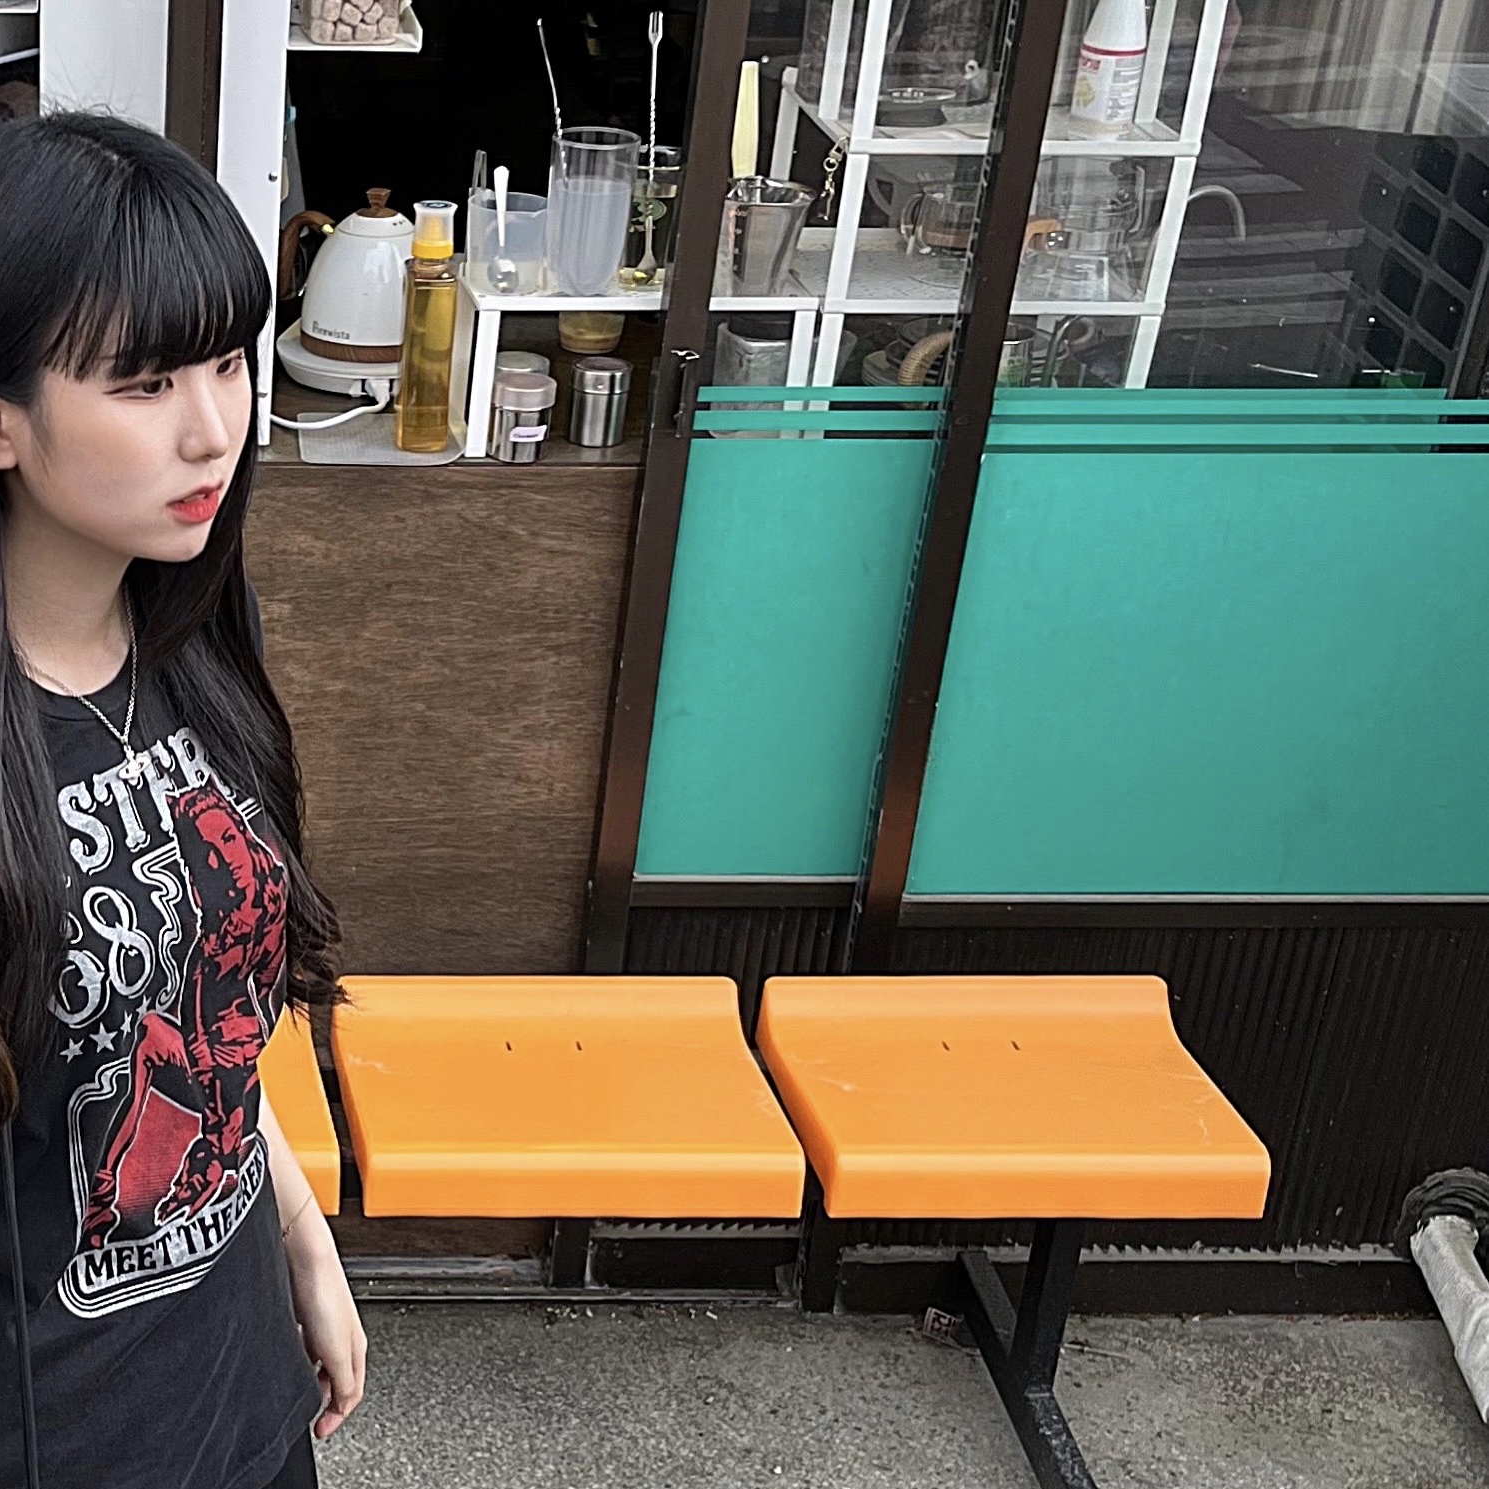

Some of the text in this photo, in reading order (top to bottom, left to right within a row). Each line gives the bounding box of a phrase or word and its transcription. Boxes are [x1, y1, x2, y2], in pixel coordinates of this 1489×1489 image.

[57, 727, 231, 875] STER
[84, 1235, 173, 1287] MEET
[175, 1202, 233, 1255] THE
